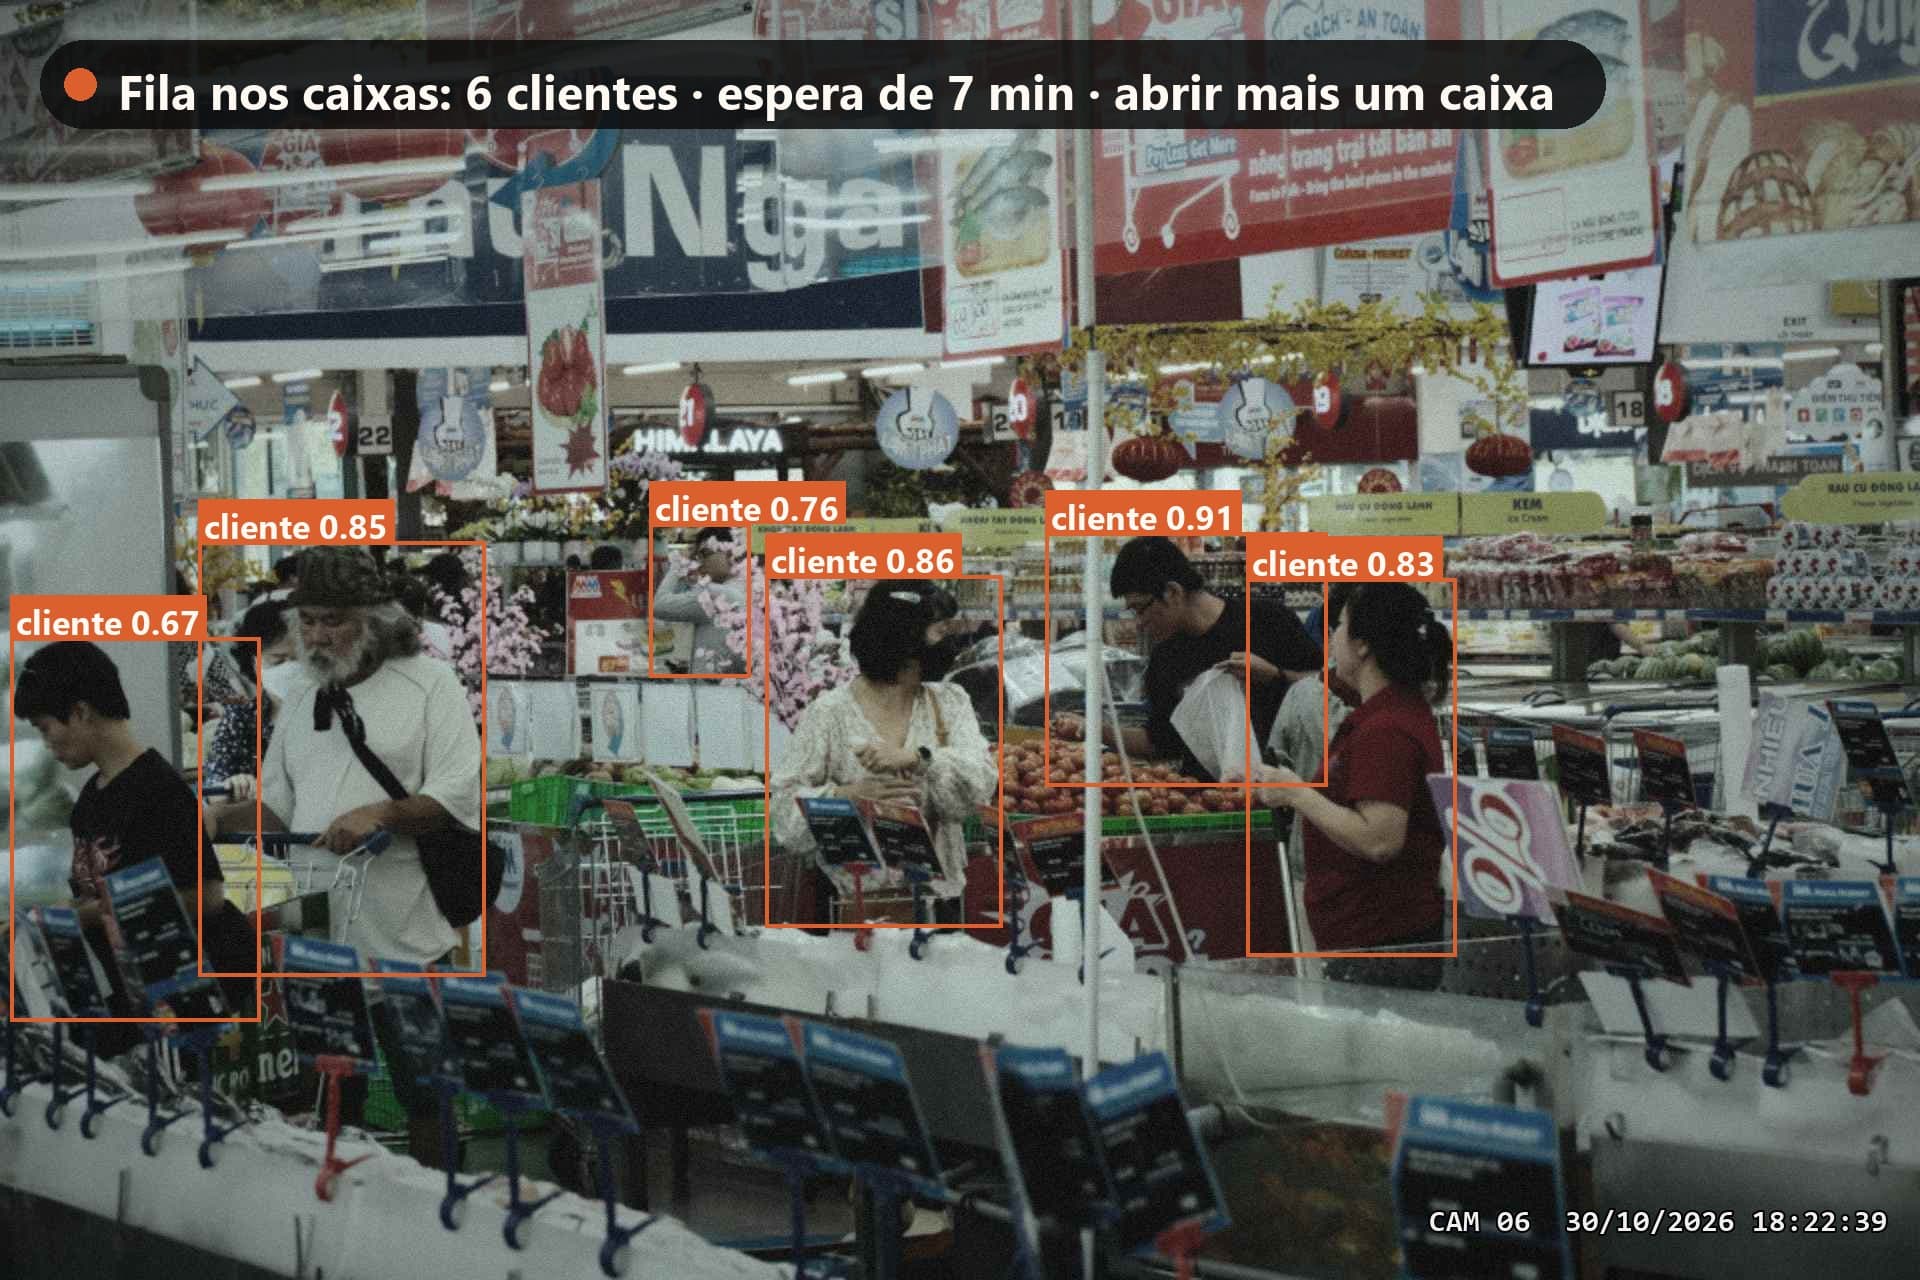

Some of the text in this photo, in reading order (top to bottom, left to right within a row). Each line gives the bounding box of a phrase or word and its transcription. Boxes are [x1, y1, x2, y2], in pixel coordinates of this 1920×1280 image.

[1616, 400, 1643, 418] 18
[359, 426, 391, 446] 22
[633, 428, 784, 453] HIMLAYA
[1512, 498, 1543, 511] KEM
